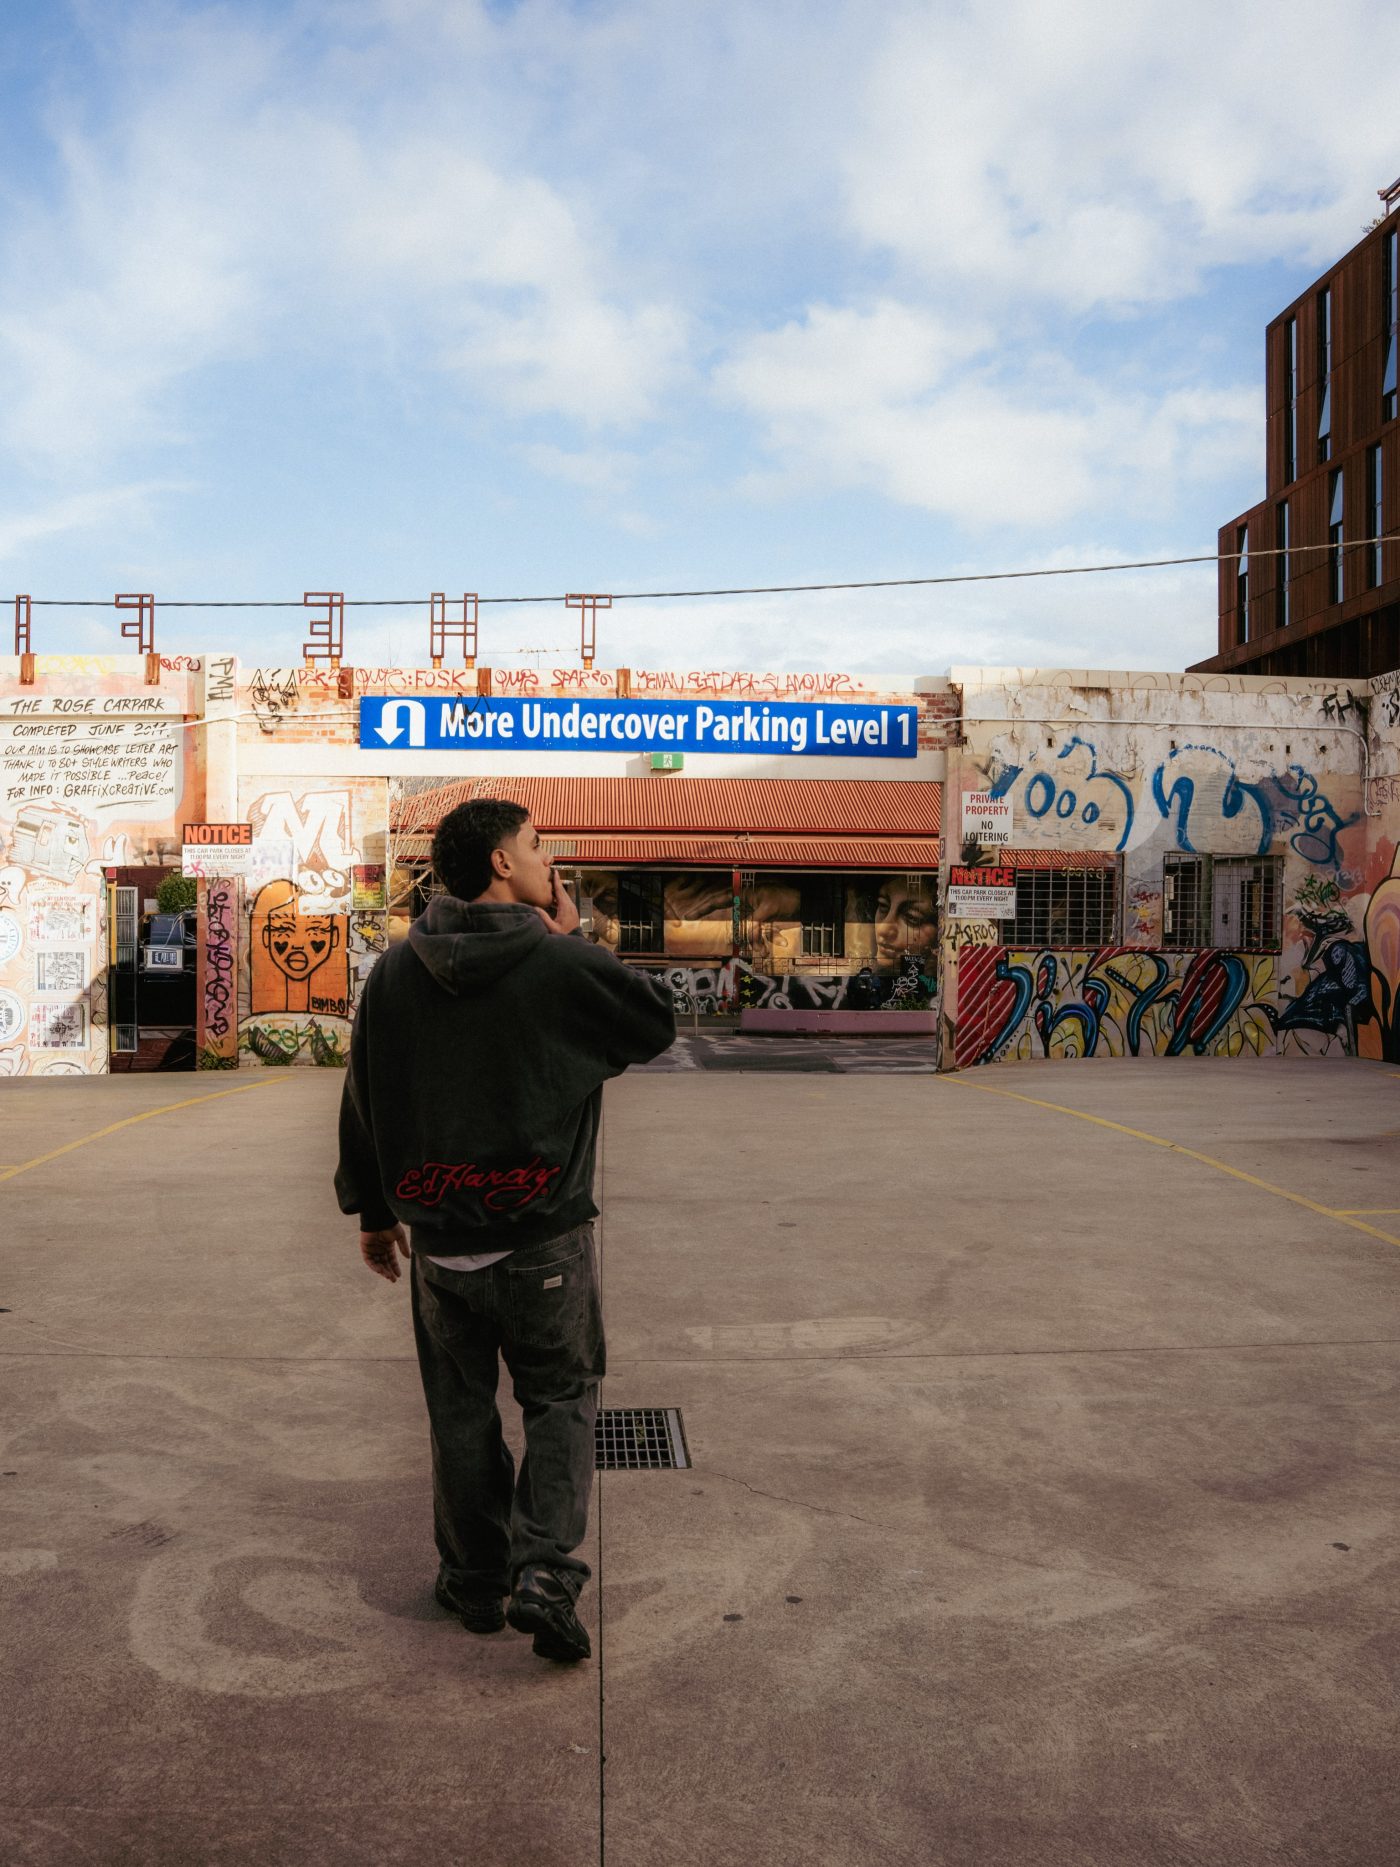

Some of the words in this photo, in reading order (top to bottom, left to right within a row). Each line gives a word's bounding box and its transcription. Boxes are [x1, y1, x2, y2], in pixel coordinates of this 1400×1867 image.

[10, 699, 42, 715] THE
[52, 698, 96, 713] ROSE
[103, 698, 165, 713] CARPARK
[13, 724, 77, 737] COMPLETED
[440, 703, 514, 738] More
[522, 702, 688, 741] Undercover
[695, 706, 808, 752] Parking
[815, 709, 888, 746] Level
[896, 713, 909, 746] 1
[4, 745, 26, 755] OUR
[47, 744, 57, 755] IS
[60, 745, 70, 755] TO
[73, 744, 120, 755] SHOWCASE
[125, 743, 154, 754] LETTER
[158, 743, 179, 755] ART
[3, 759, 36, 769] THANK
[38, 759, 45, 769] U
[152, 758, 173, 768] WHO
[18, 771, 46, 783] MADE
[965, 805, 1009, 816] PROPERTY
[981, 820, 993, 831] NO
[184, 825, 251, 844] NOTICE
[965, 832, 1009, 843] LOITERING
[951, 866, 1014, 886] NOTICE
